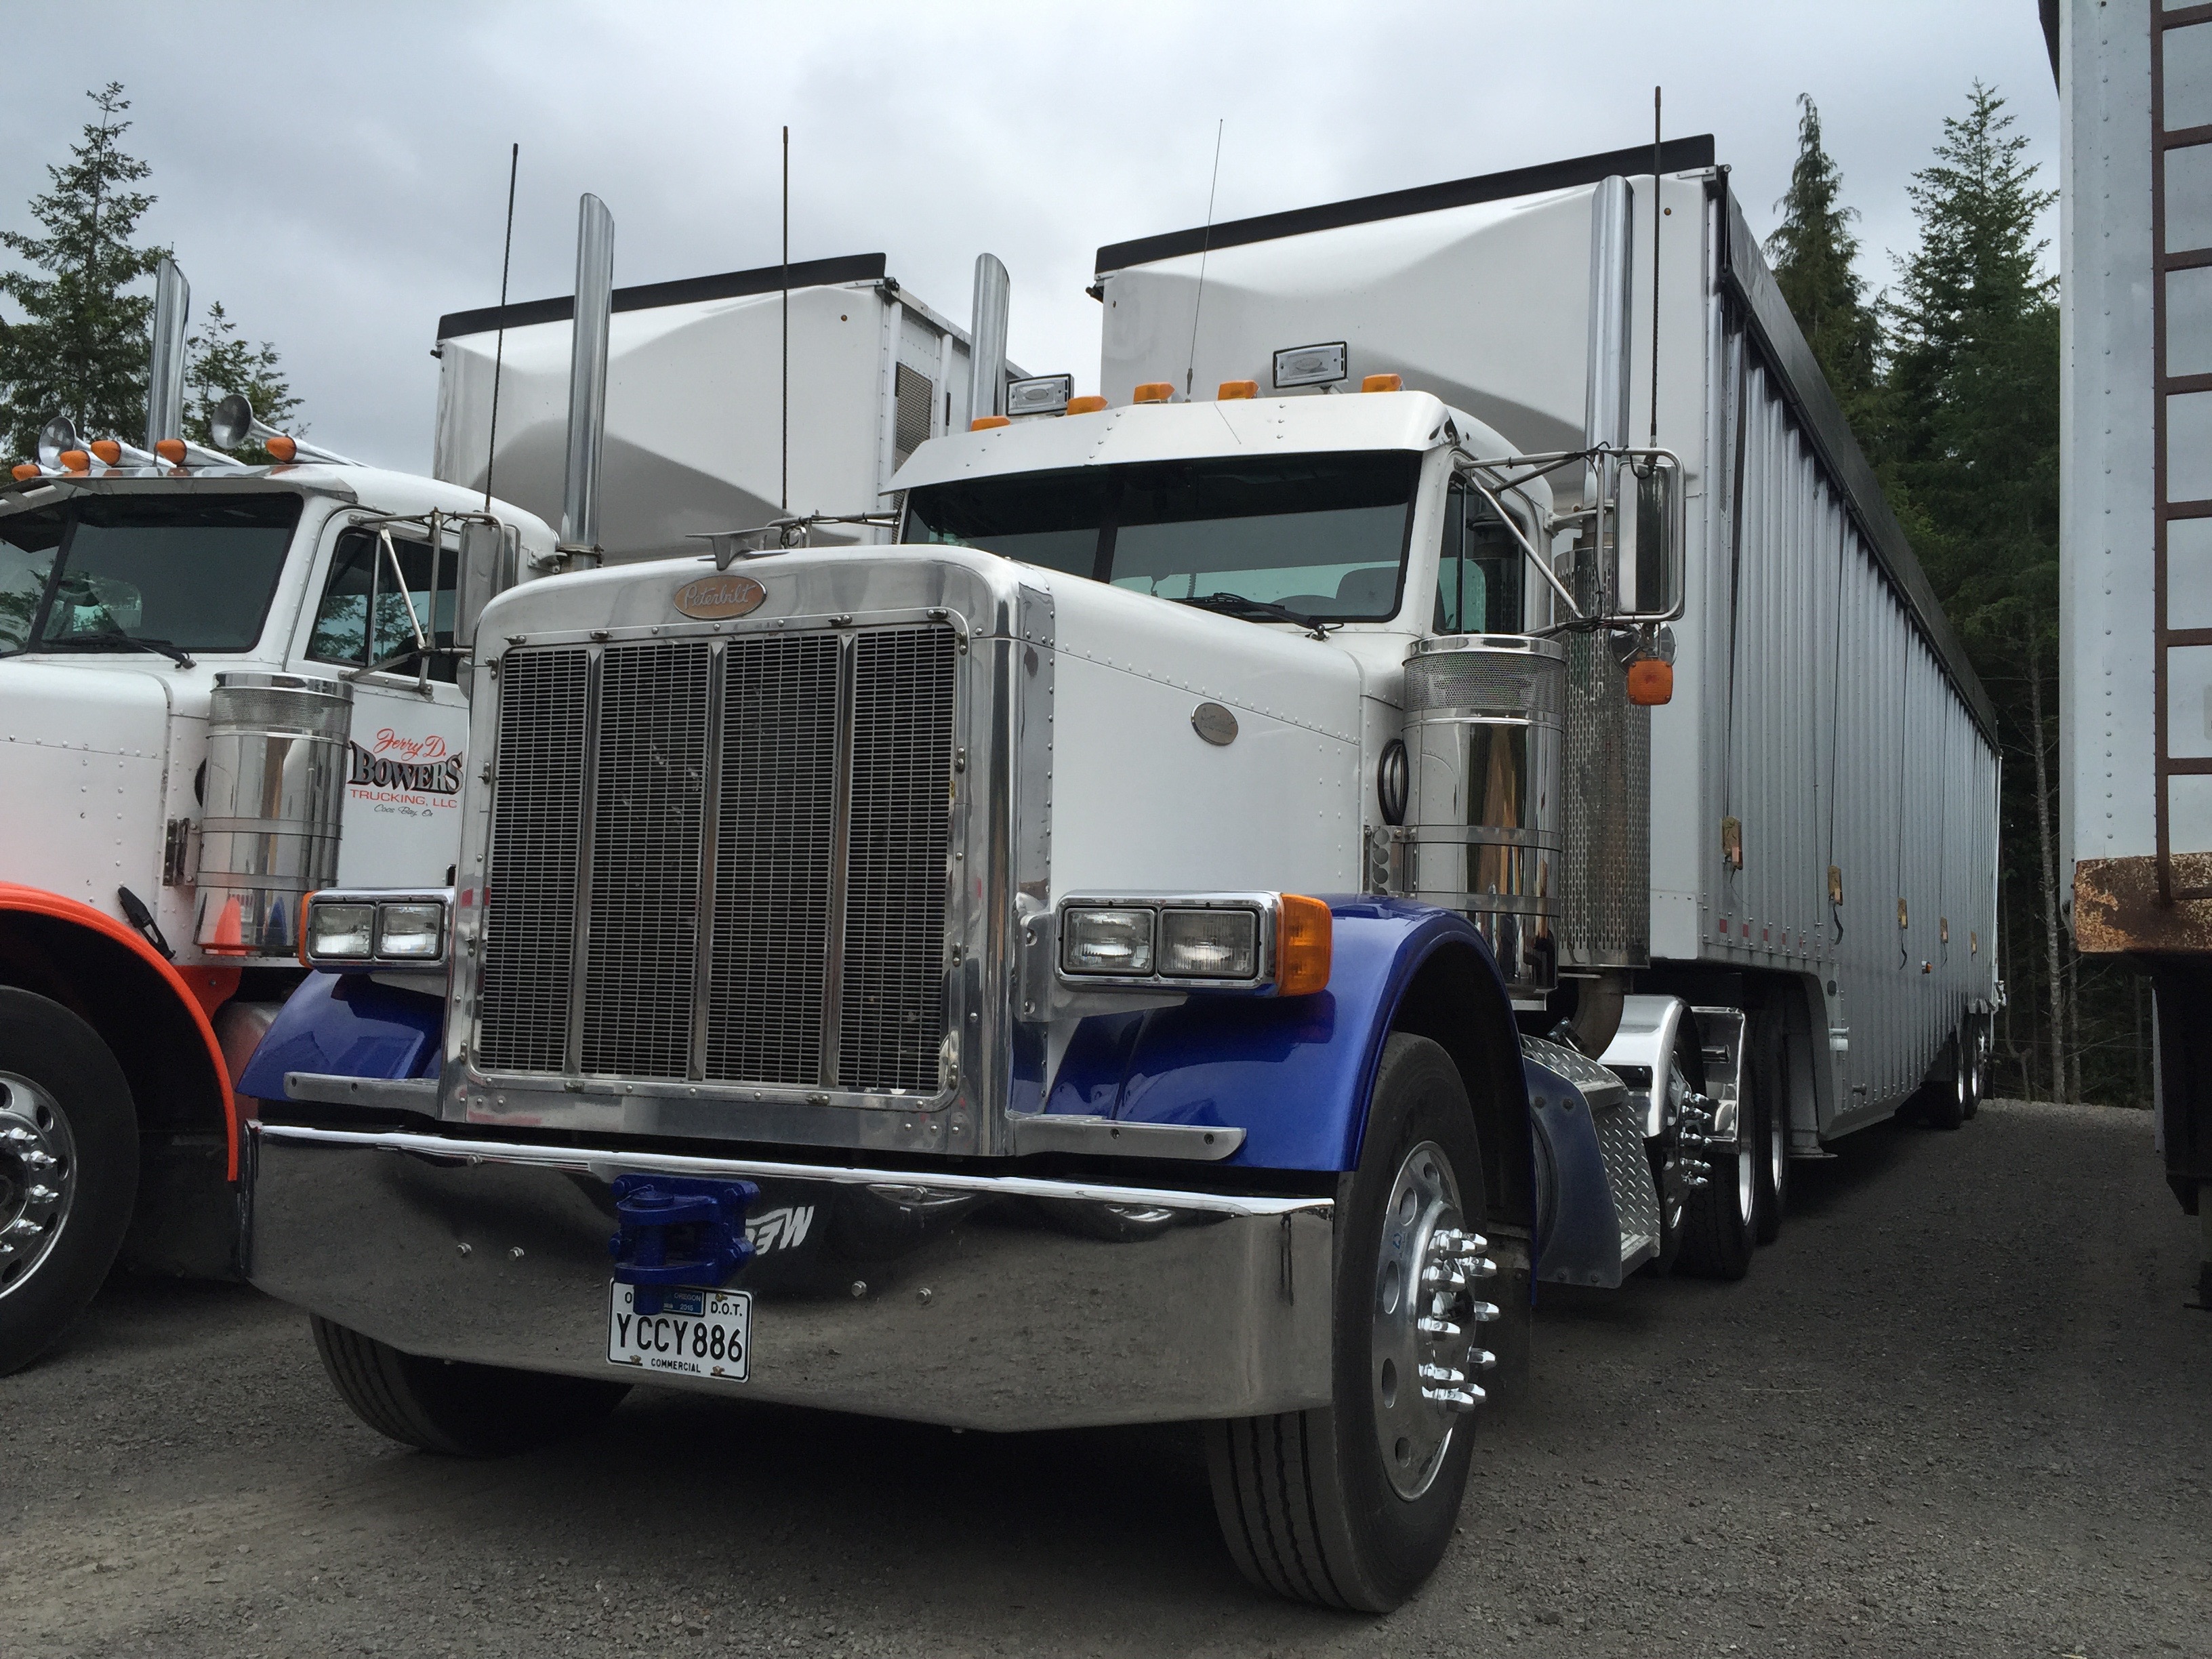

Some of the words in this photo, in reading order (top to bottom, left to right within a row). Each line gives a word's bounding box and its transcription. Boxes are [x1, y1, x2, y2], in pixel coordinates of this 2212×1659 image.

[684, 584, 757, 609] Peterbilt
[373, 728, 423, 761] Jerry
[424, 735, 447, 758] D.
[348, 740, 464, 794] BOWERS
[350, 789, 428, 806] TRUCKING,
[432, 798, 457, 808] LLC
[374, 804, 395, 813] Coos
[674, 1292, 701, 1302] OREGON
[710, 1301, 743, 1317] D.O.T.
[617, 1313, 743, 1362] YCCY886
[651, 1357, 701, 1373] COMMERCIAL
